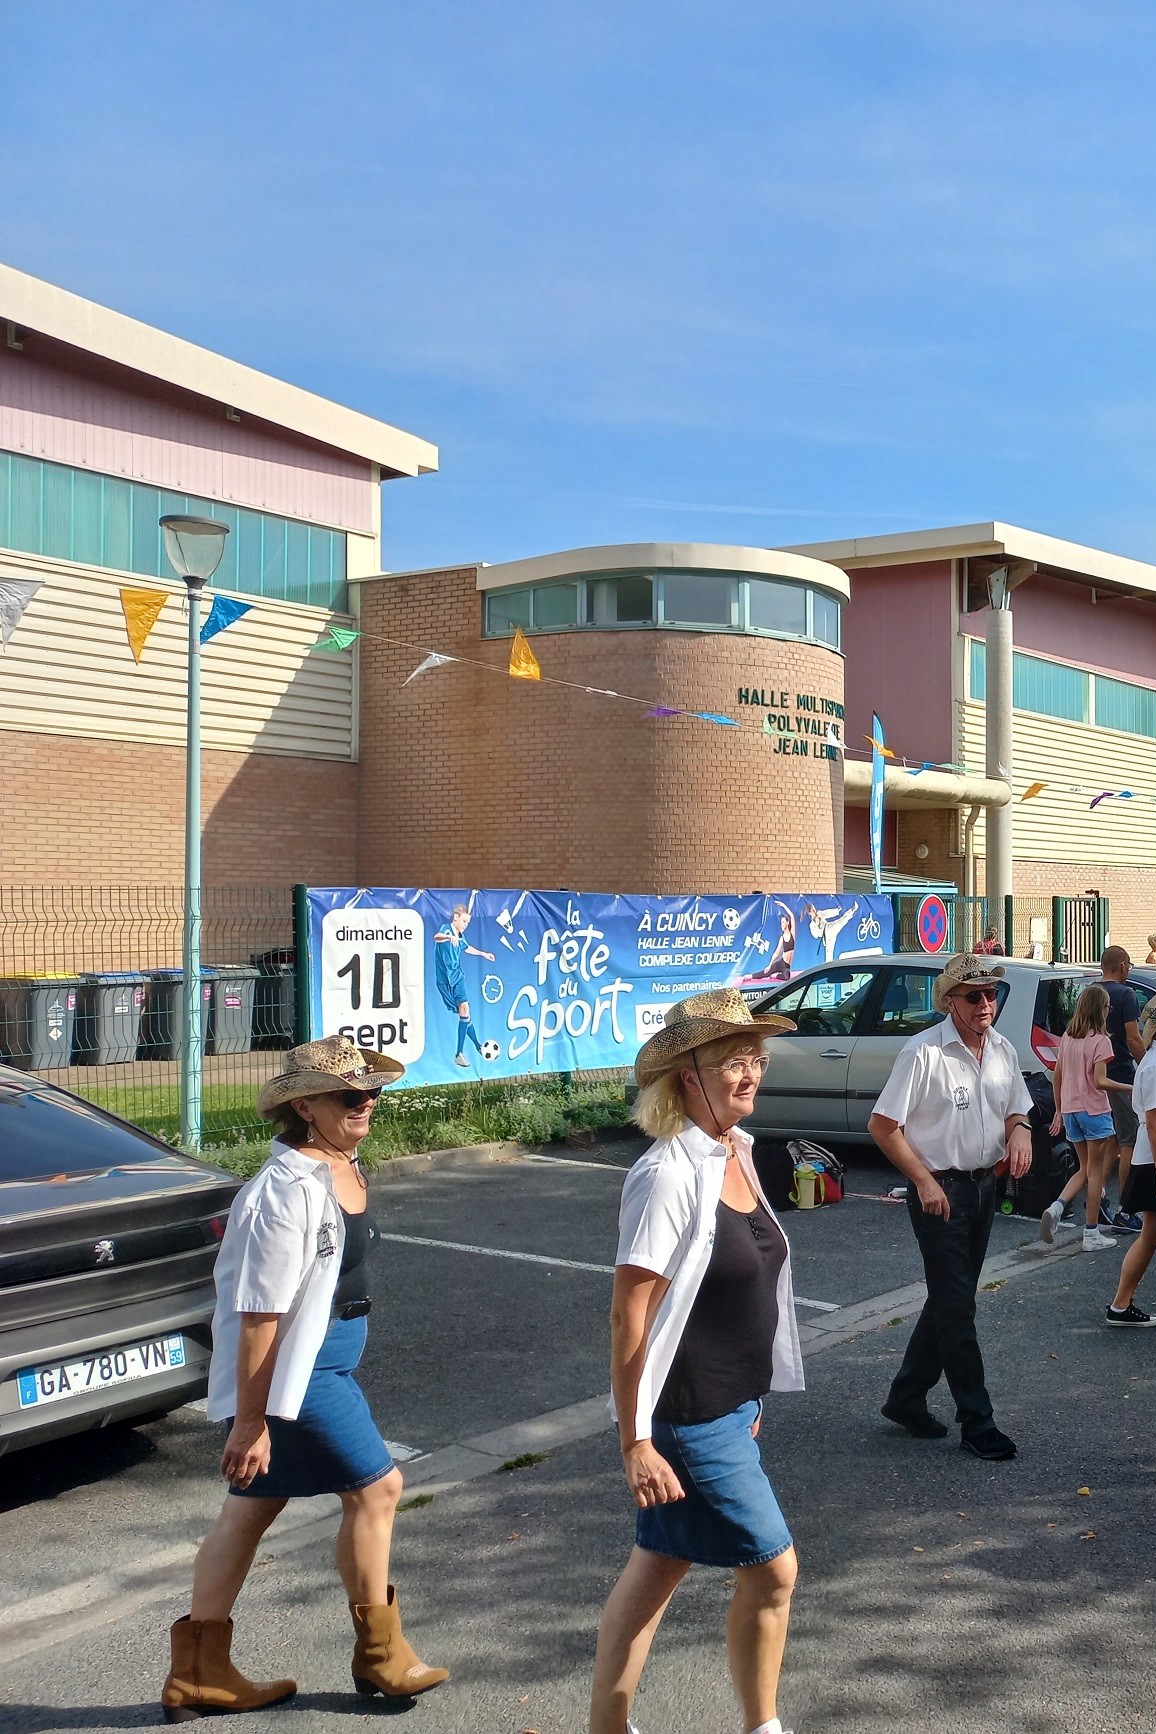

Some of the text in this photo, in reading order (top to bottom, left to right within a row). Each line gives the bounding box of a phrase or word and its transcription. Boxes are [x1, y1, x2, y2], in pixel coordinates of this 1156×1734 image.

[738, 687, 790, 709] HALLE
[773, 738, 809, 756] JEAN
[566, 900, 581, 926] la
[637, 909, 718, 932] À CUINCY
[336, 926, 413, 942] dimanche
[638, 935, 735, 950] HALLE JEAN LENNE
[533, 924, 610, 986] fête
[639, 952, 741, 968] COMPLEXE COUDERC
[337, 953, 401, 1010] 10
[558, 977, 578, 999] du
[652, 979, 723, 995] Nos partenaires
[506, 977, 634, 1065] Sport
[642, 1010, 664, 1026] Cré
[338, 1018, 408, 1053] sept
[39, 1341, 184, 1396] GA-780-VN 59
[26, 1390, 32, 1400] F
